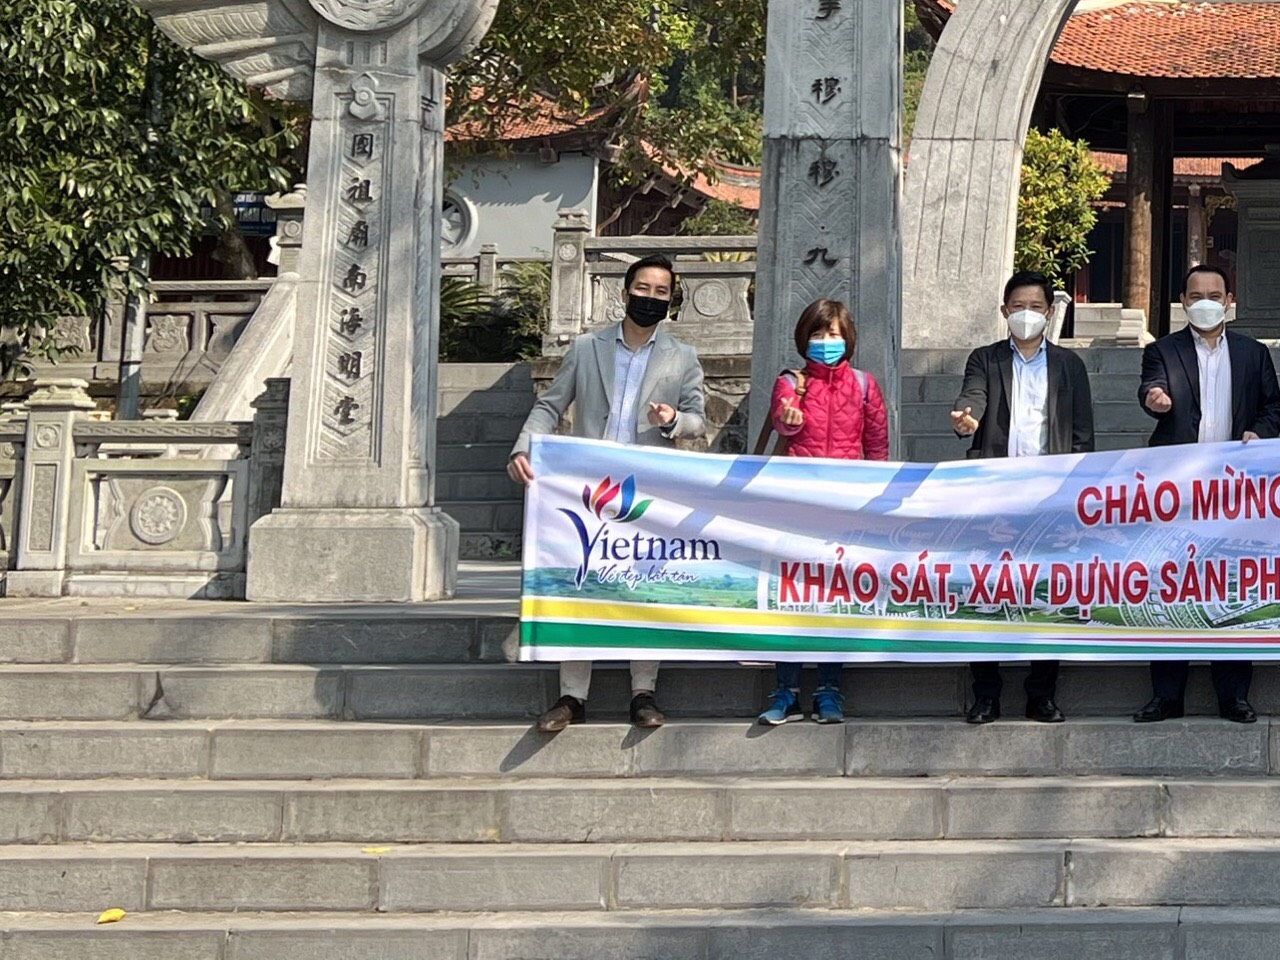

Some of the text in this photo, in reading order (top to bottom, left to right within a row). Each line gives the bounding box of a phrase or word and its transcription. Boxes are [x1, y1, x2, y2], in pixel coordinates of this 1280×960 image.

[1078, 472, 1180, 525] CHÀO
[556, 508, 722, 587] Vietnam
[779, 547, 880, 603] KHẢO
[890, 551, 957, 613] SÁT,
[969, 552, 1040, 606] XÂY
[1051, 555, 1149, 620] DỰNG
[1161, 544, 1226, 603] SẢN
